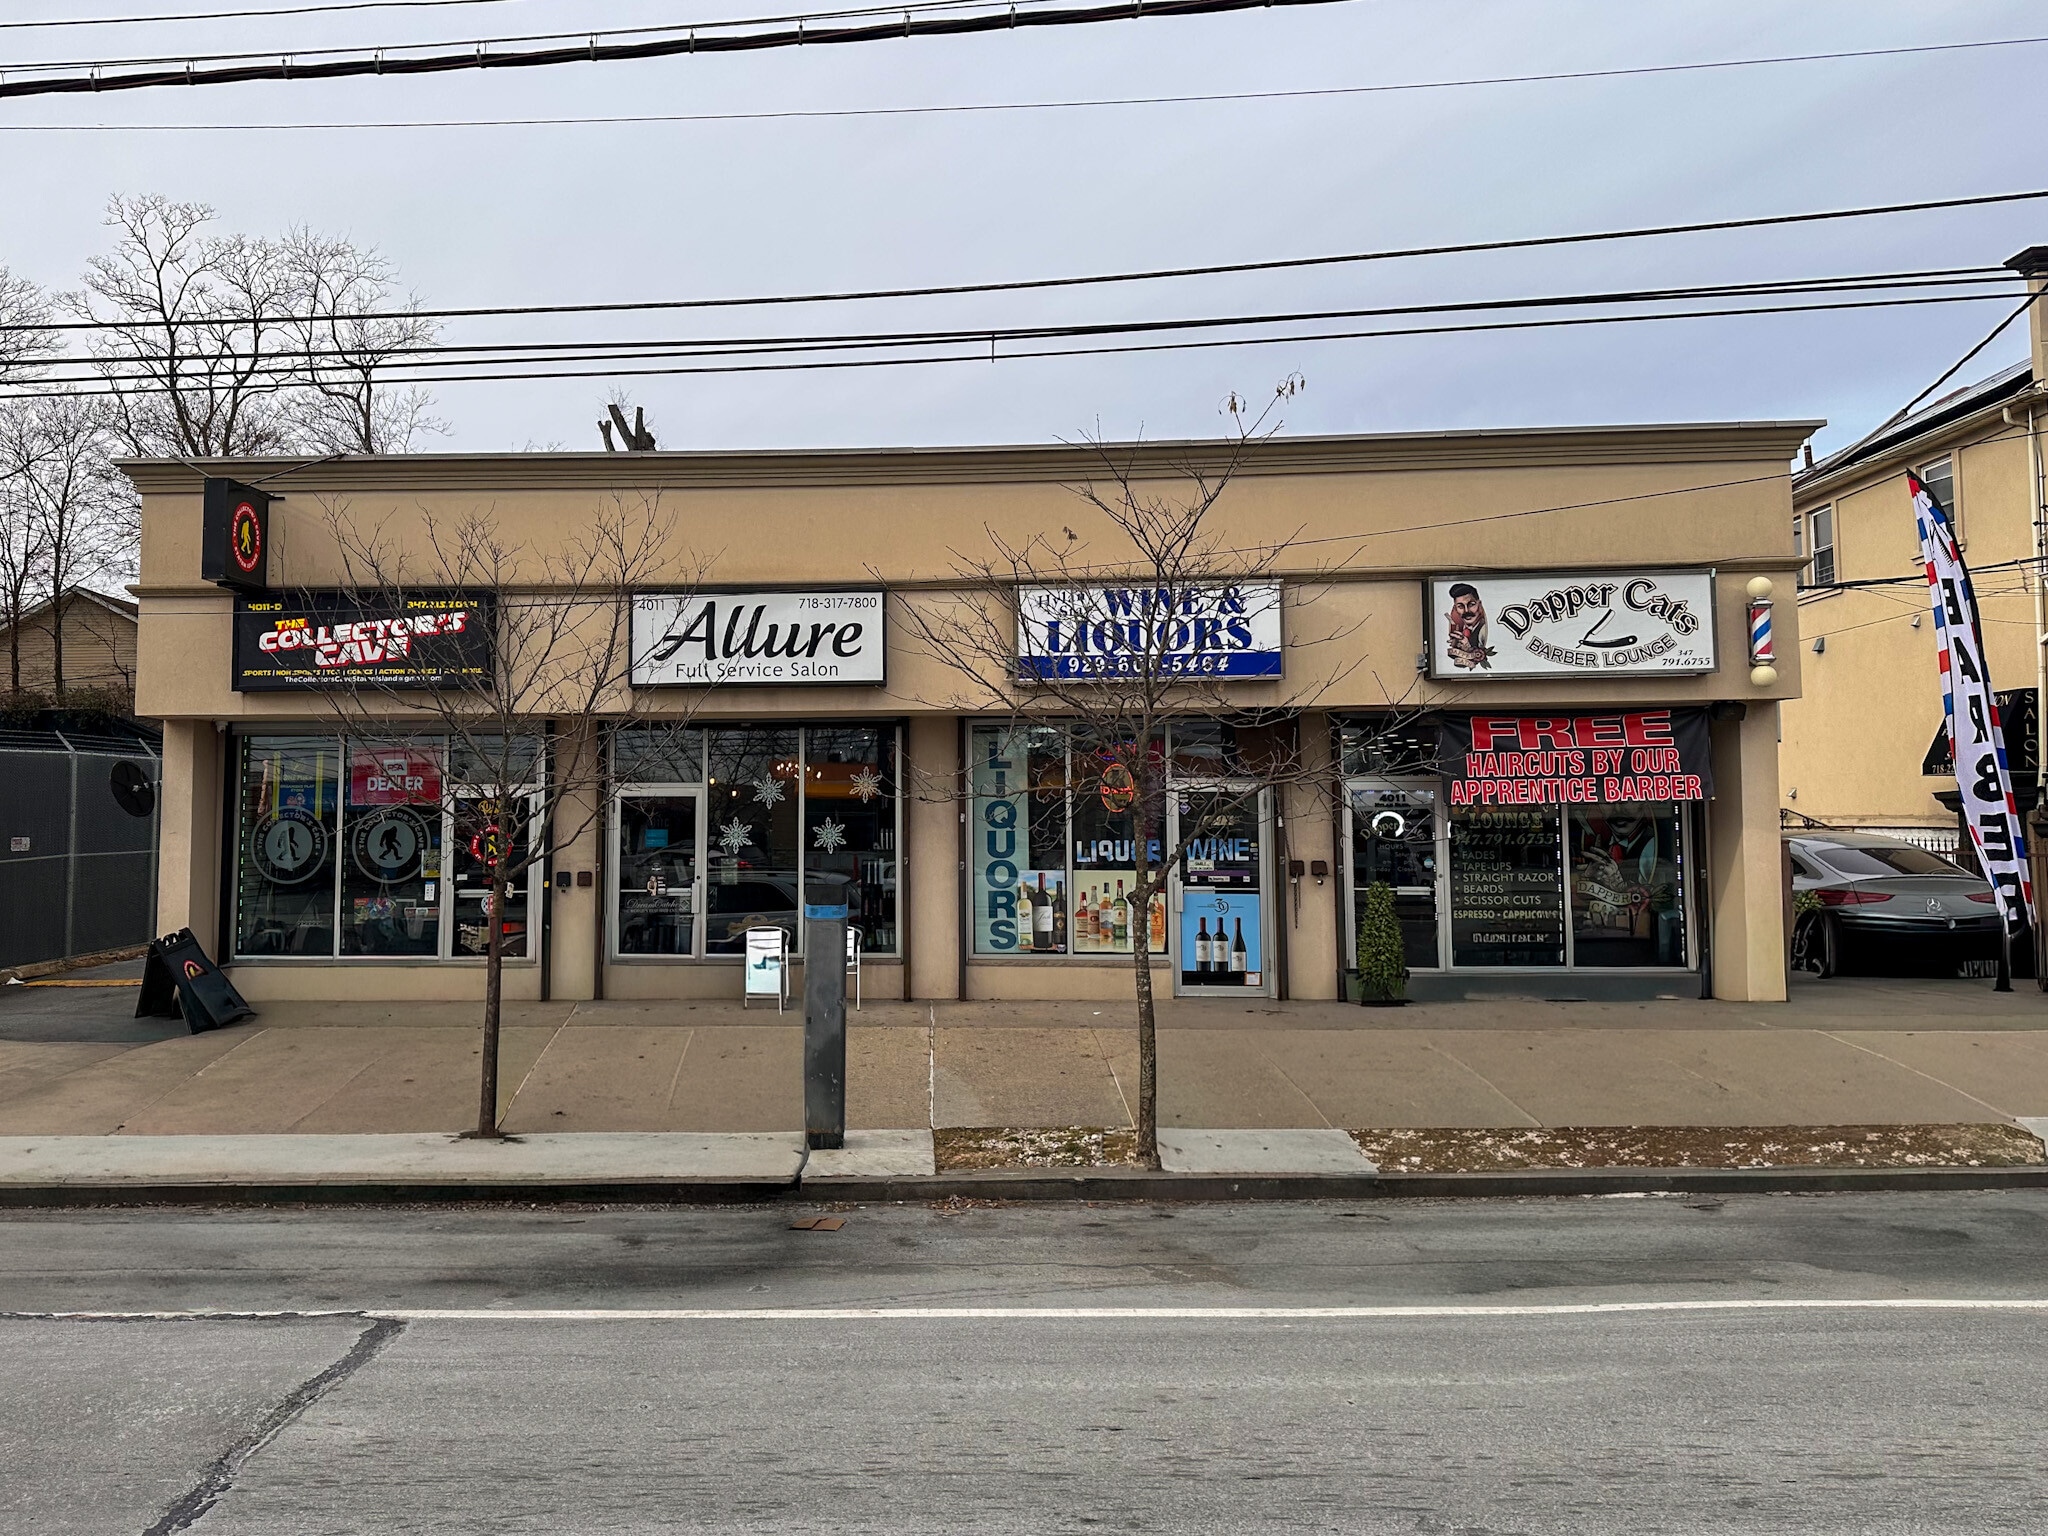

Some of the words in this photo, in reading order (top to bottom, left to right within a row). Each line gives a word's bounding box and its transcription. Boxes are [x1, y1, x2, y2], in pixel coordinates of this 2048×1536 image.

[639, 600, 665, 611] 4011
[799, 597, 877, 609] 718-317-7800
[1103, 588, 1204, 616] WINE
[1218, 587, 1247, 615] &
[1497, 582, 1618, 640] Dapper
[1623, 577, 1699, 637] Cats
[259, 612, 468, 652] COLLECTOR'S
[275, 618, 305, 630] THE
[654, 601, 863, 662] Allure
[1046, 617, 1253, 659] LIQUORS
[315, 636, 410, 669] CAVE
[1526, 635, 1600, 668] BARBER
[1603, 633, 1678, 667] LOUNGE
[676, 663, 708, 678] Full
[717, 663, 783, 678] Service
[791, 662, 839, 677] Salon
[1662, 657, 1710, 666] 791.6755
[1470, 710, 1675, 752] FREE
[2024, 691, 2039, 768] SALON
[1465, 750, 1586, 778] HAIRCUTS
[1592, 749, 1624, 775] BY
[1630, 748, 1681, 774] OUR
[367, 776, 424, 791] DEALER
[1450, 777, 1598, 805] APPRENTICE
[1604, 774, 1704, 801] BARBER
[1379, 794, 1406, 802] 4011
[1468, 811, 1544, 829] LOUNGE
[983, 741, 1018, 950] LIQUORS
[1451, 832, 1555, 846] 347.791.6755
[1186, 837, 1249, 861] WINE
[1462, 850, 1496, 860] FADES
[1462, 861, 1512, 871] TAPE-UPS
[1462, 873, 1515, 883] STRAIGHT
[1517, 872, 1555, 883] RAZOR
[1463, 884, 1504, 894] BEARDS
[1578, 882, 1631, 903] DAPPER
[1463, 895, 1510, 905] SCISSOR
[1512, 894, 1542, 905] CUTS
[1453, 910, 1495, 920] ESPRESSO
